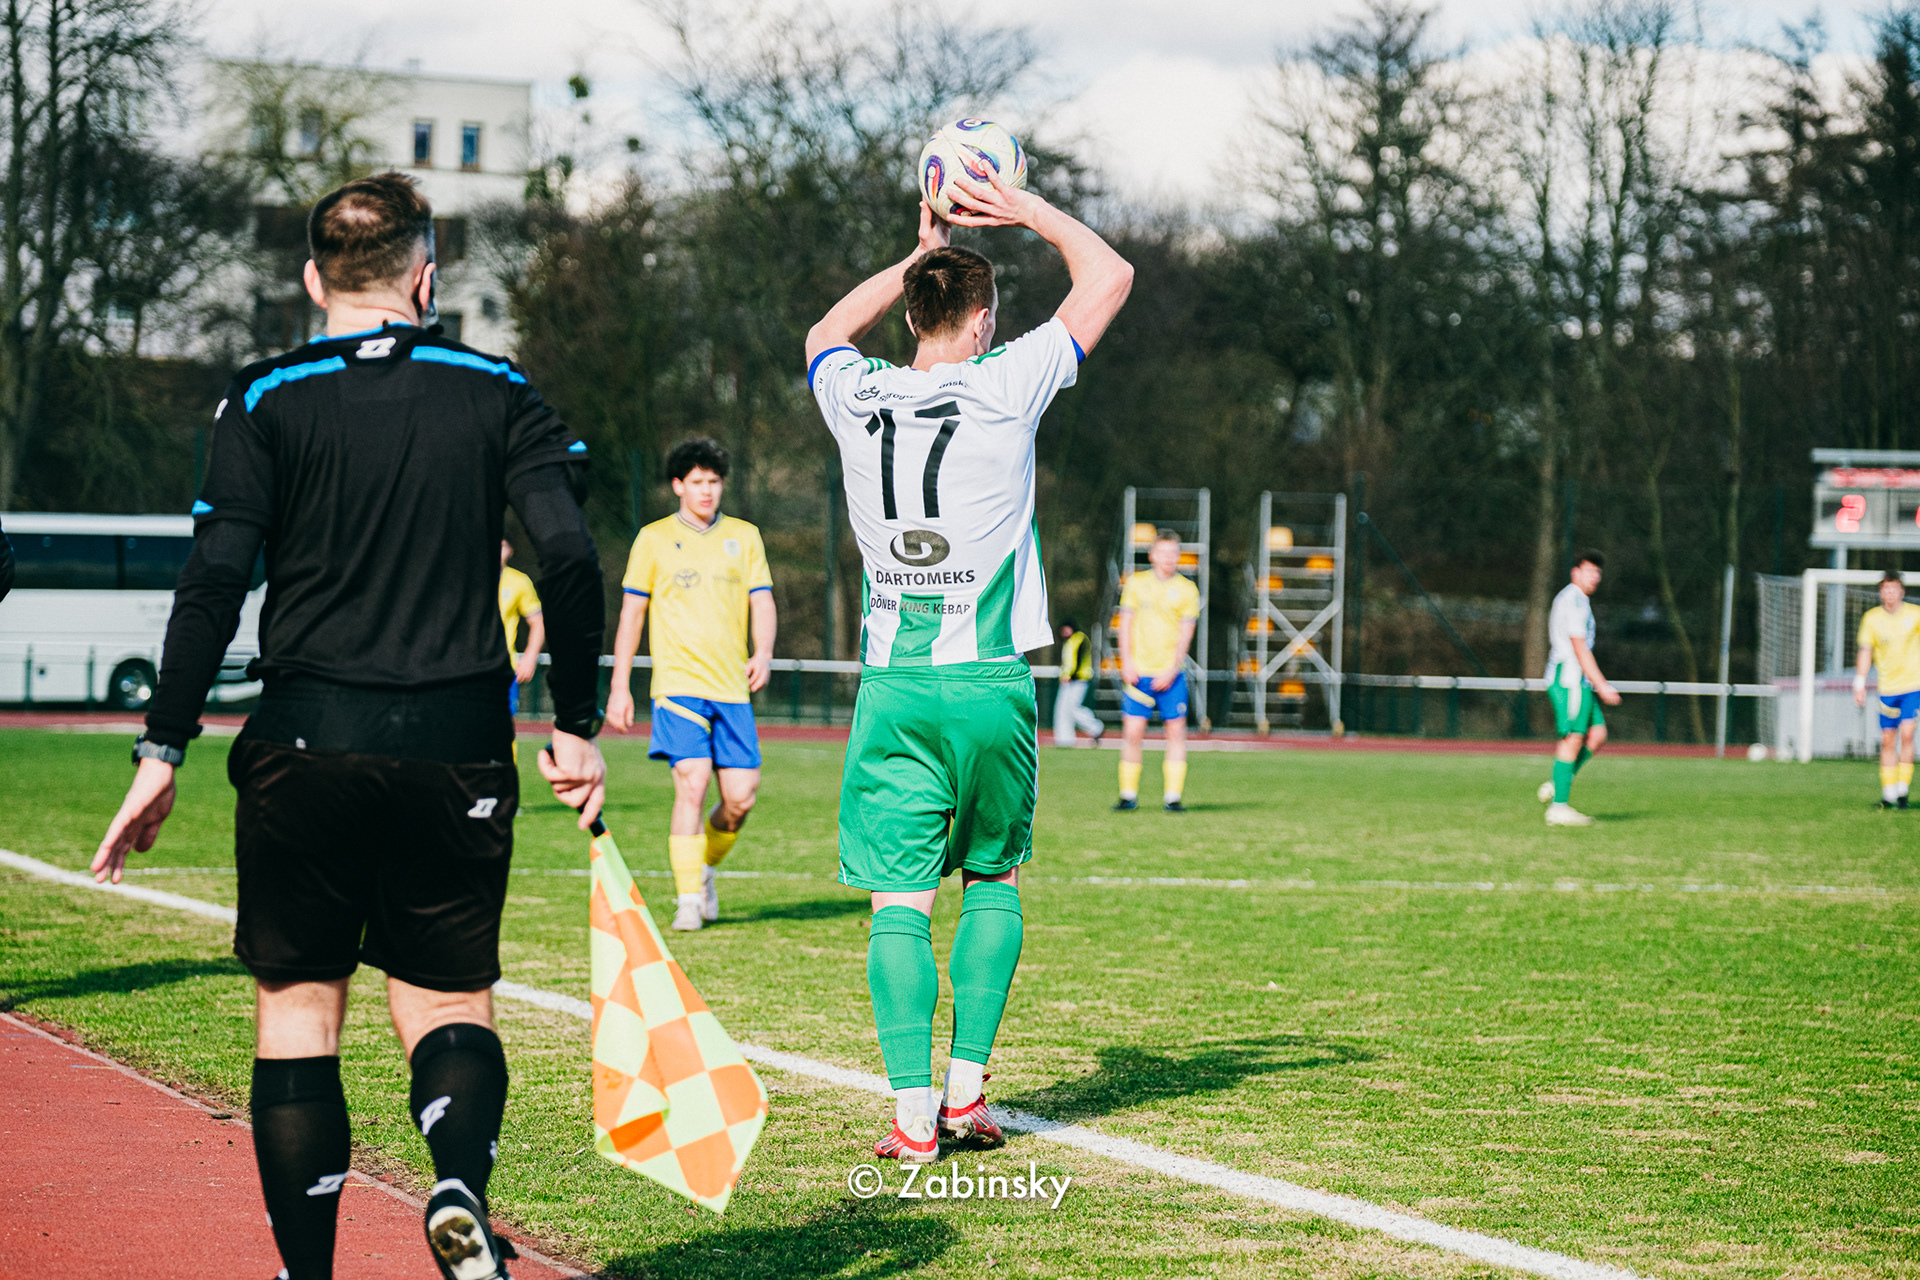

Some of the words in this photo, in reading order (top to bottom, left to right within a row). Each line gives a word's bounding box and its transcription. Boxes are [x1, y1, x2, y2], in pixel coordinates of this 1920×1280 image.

[865, 400, 961, 520] 17
[1835, 494, 1867, 534] 2
[875, 569, 976, 586] DARTOMEKS
[870, 594, 897, 611] DÖNER
[900, 601, 930, 614] KING
